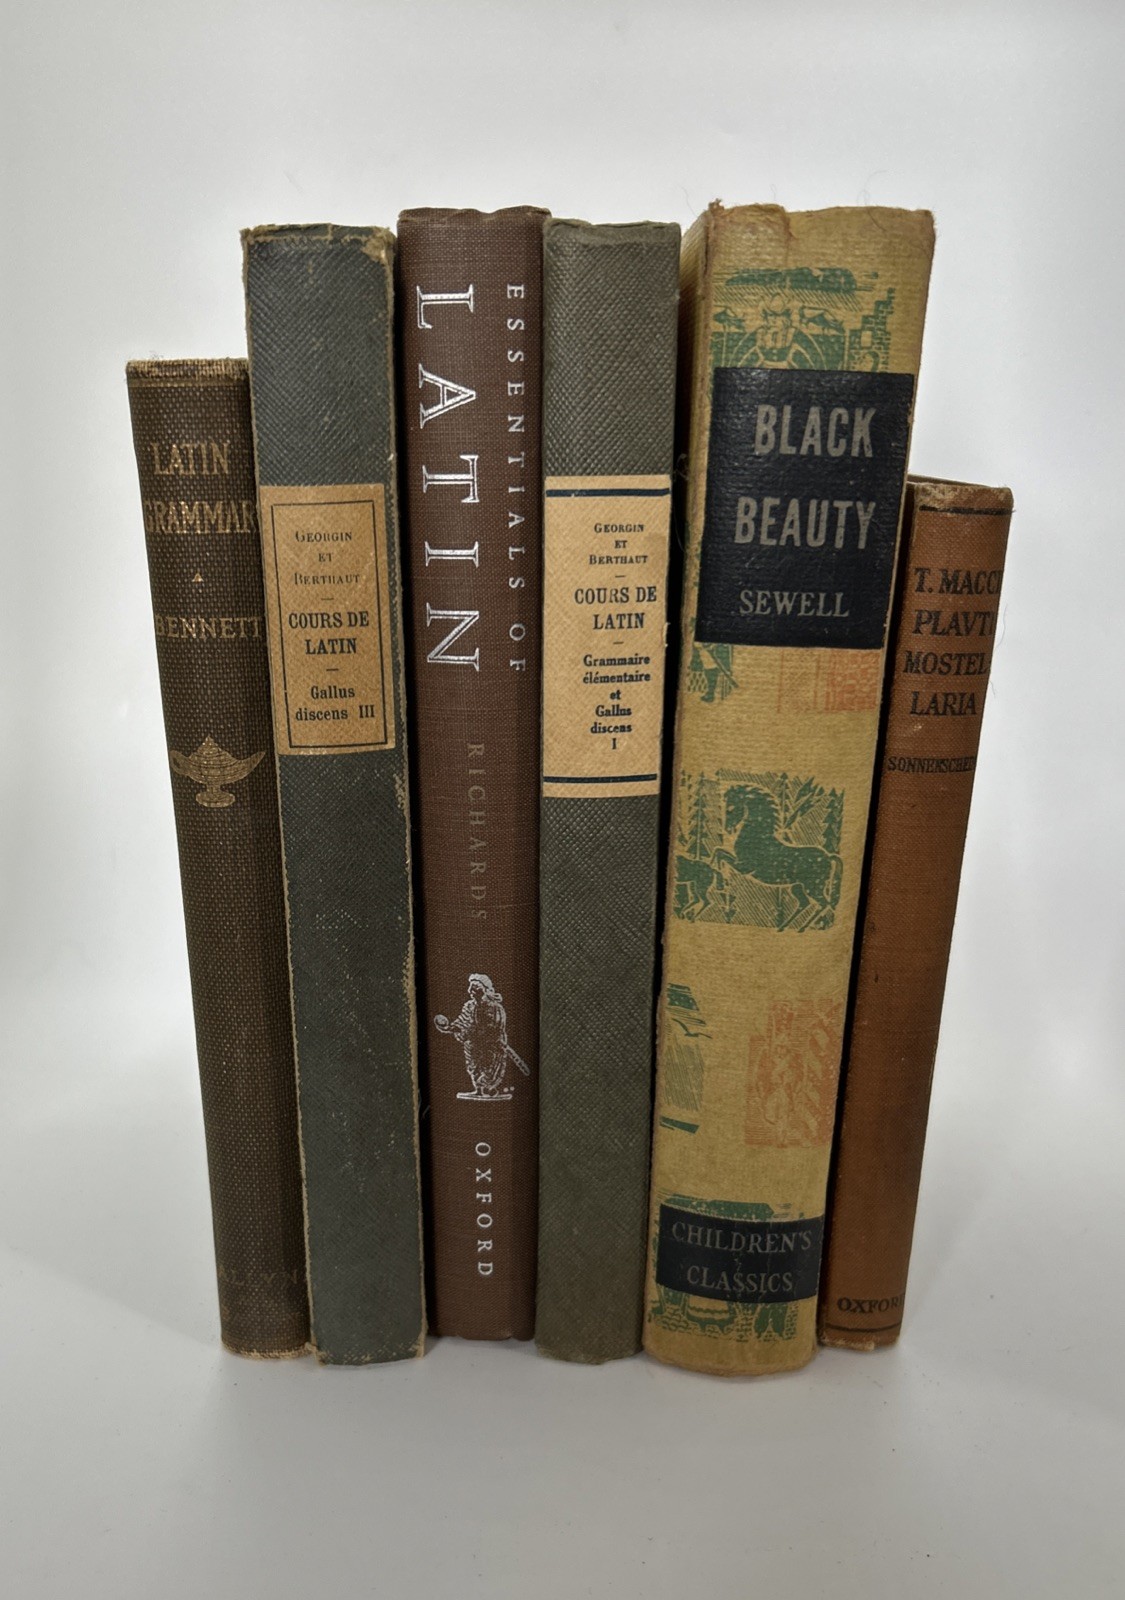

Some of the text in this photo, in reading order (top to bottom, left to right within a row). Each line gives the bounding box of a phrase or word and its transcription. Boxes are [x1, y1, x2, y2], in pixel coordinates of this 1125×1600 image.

[754, 404, 876, 457] BLACK
[150, 442, 230, 475] LATIN
[416, 284, 480, 671] LATIN
[507, 284, 526, 671] ESSENTIALS OF
[144, 500, 258, 534] GRAMMAR
[734, 497, 876, 549] BEAUTY
[614, 540, 628, 549] ET
[318, 553, 333, 562] ET
[914, 568, 933, 593] T.
[574, 586, 657, 604] COURS DE
[739, 590, 849, 617] SEWELL
[155, 616, 262, 639] BENNETT
[288, 611, 369, 629] COURS DE
[593, 612, 645, 630] LATIN
[305, 638, 357, 655] LATIN
[583, 653, 651, 667] Grammaire
[583, 670, 651, 684] élémentaire
[311, 685, 355, 699] Gallus
[609, 689, 622, 700] et
[295, 705, 375, 721] discens III
[595, 704, 632, 717] Gallus
[910, 691, 977, 716] LARIA
[590, 722, 632, 734] discens
[612, 738, 617, 750] I
[467, 743, 487, 920] RICHARDS
[475, 1142, 493, 1276] OXFORD
[672, 1222, 812, 1253] CHILDREN'S
[687, 1265, 793, 1294] CLASSICS
